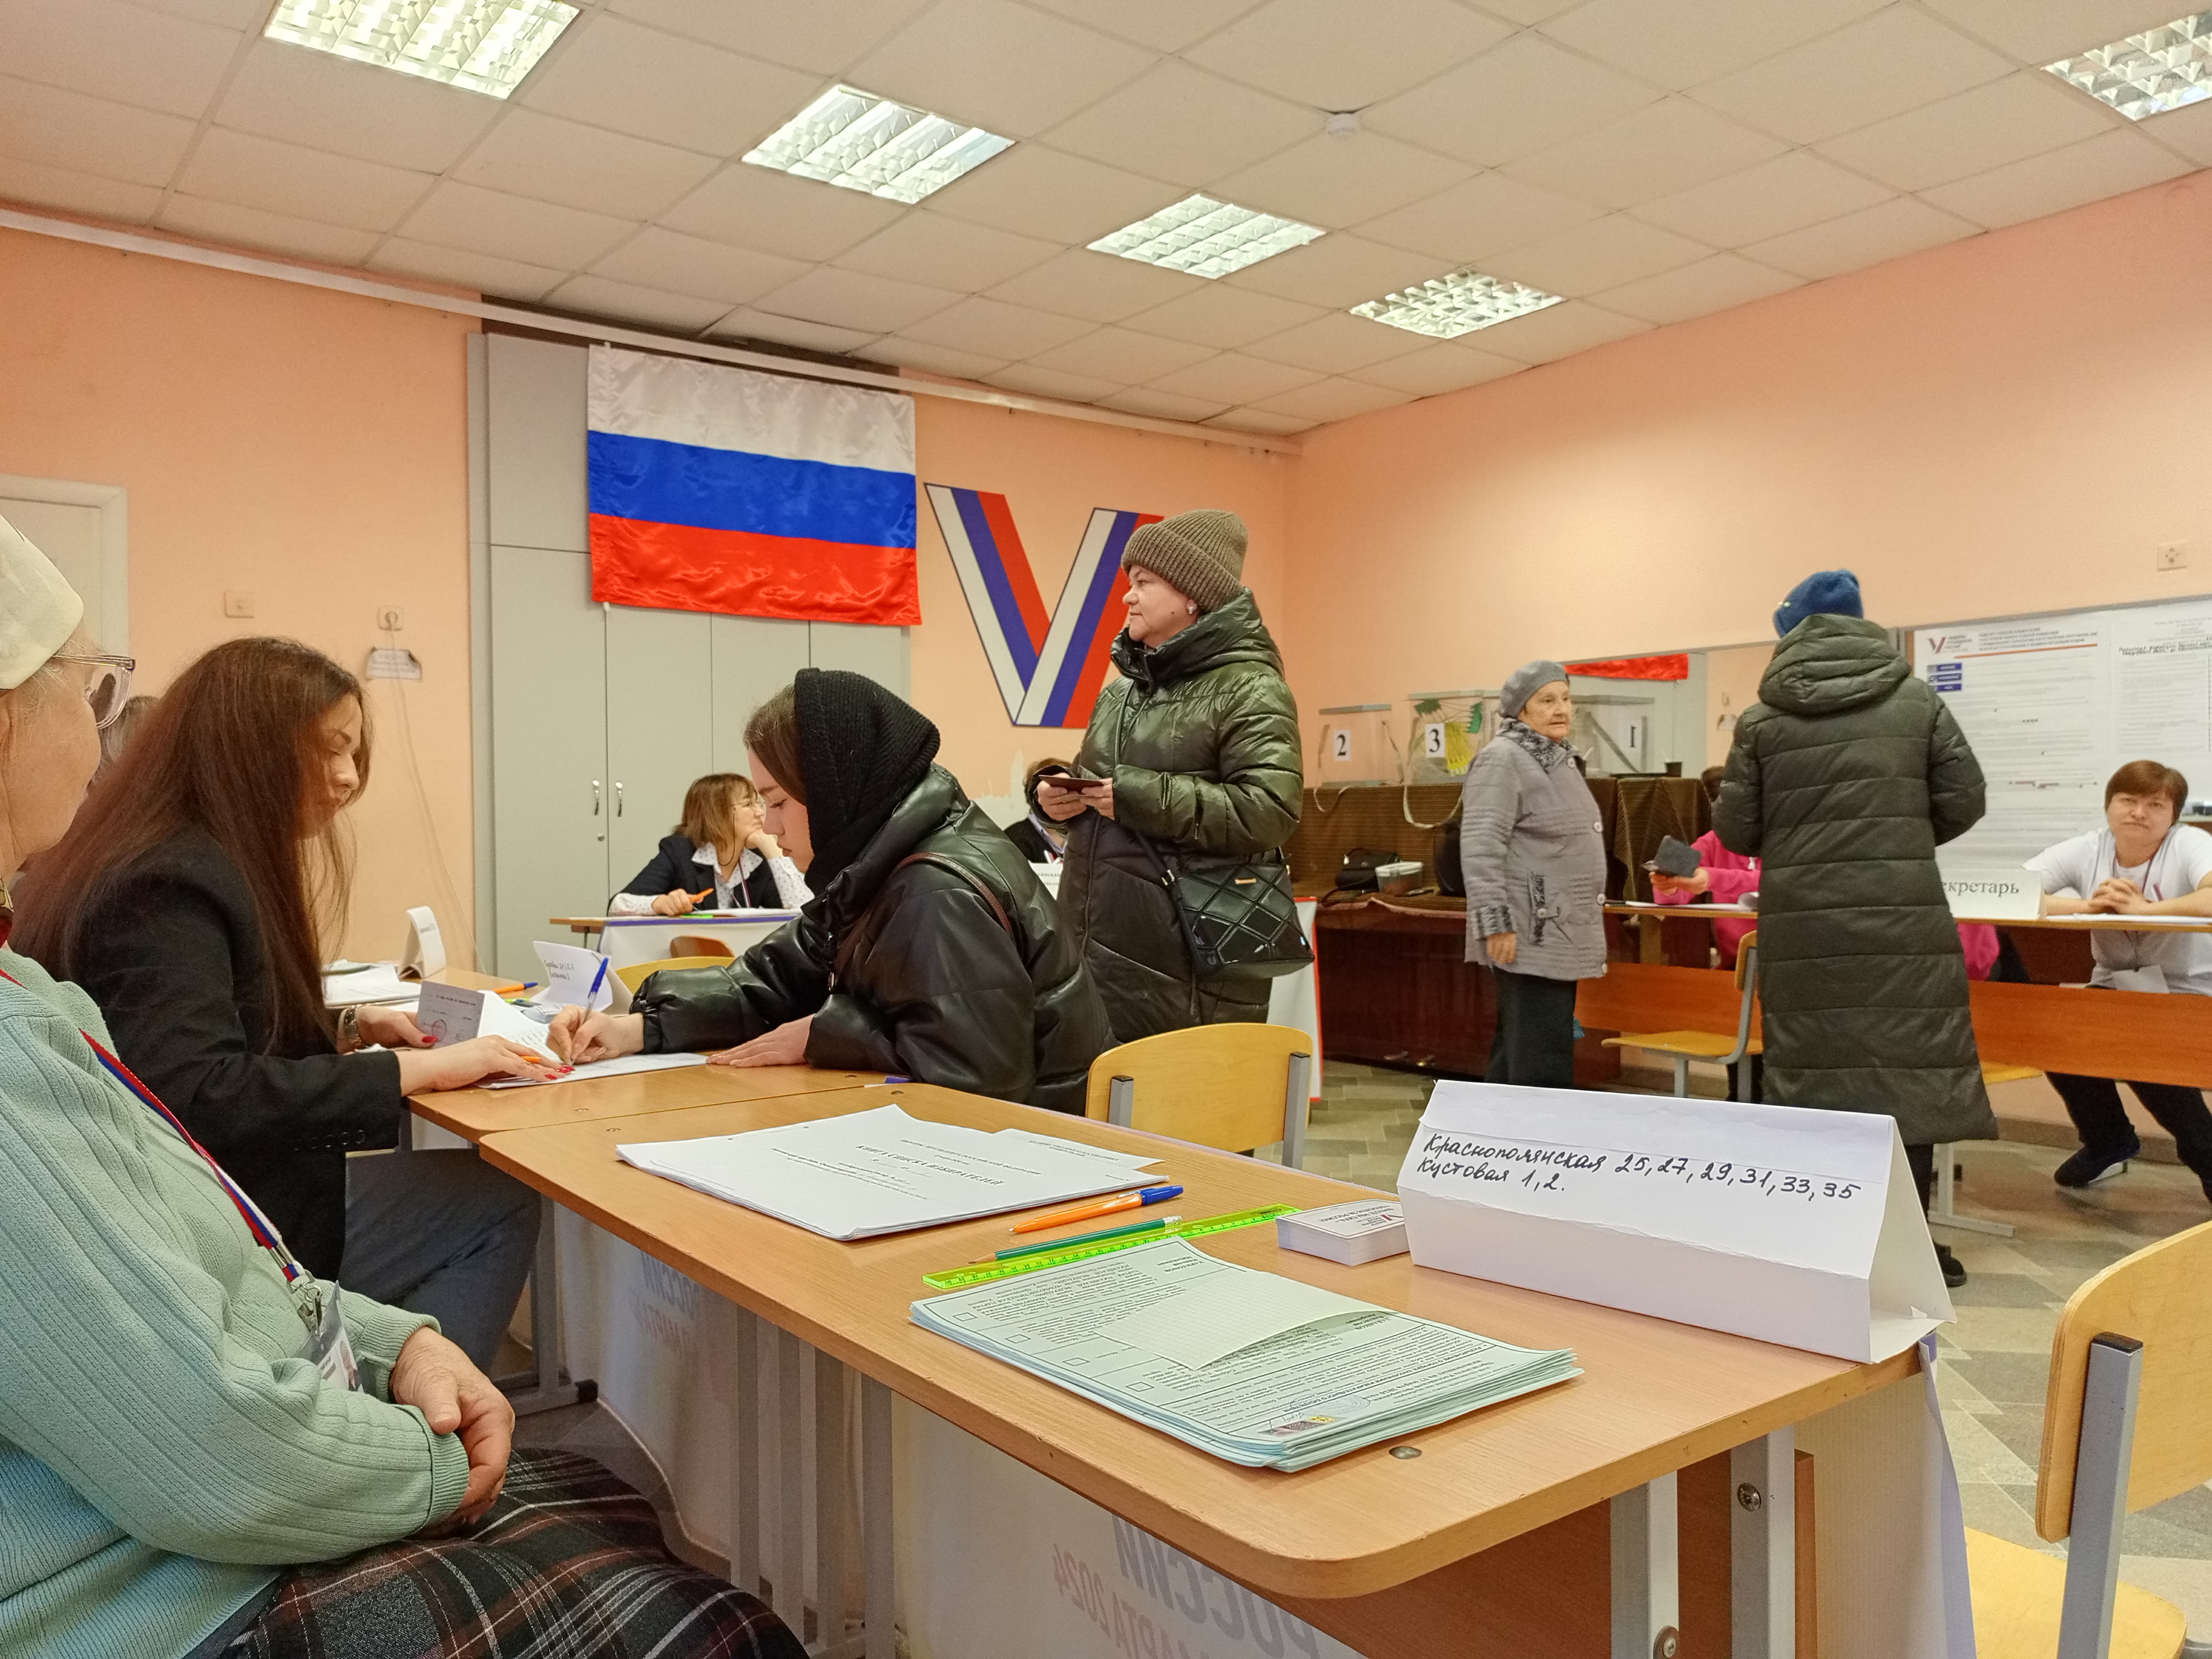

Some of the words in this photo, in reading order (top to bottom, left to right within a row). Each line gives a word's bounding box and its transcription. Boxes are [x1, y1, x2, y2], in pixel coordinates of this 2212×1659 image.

[1336, 733, 1347, 757] 2
[1429, 728, 1441, 753] 3
[1941, 880, 2019, 897] екретарь
[1417, 1156, 1510, 1181] Кустовая
[1423, 1133, 1607, 1173] Краснополянская
[1823, 1182, 1862, 1199] 35
